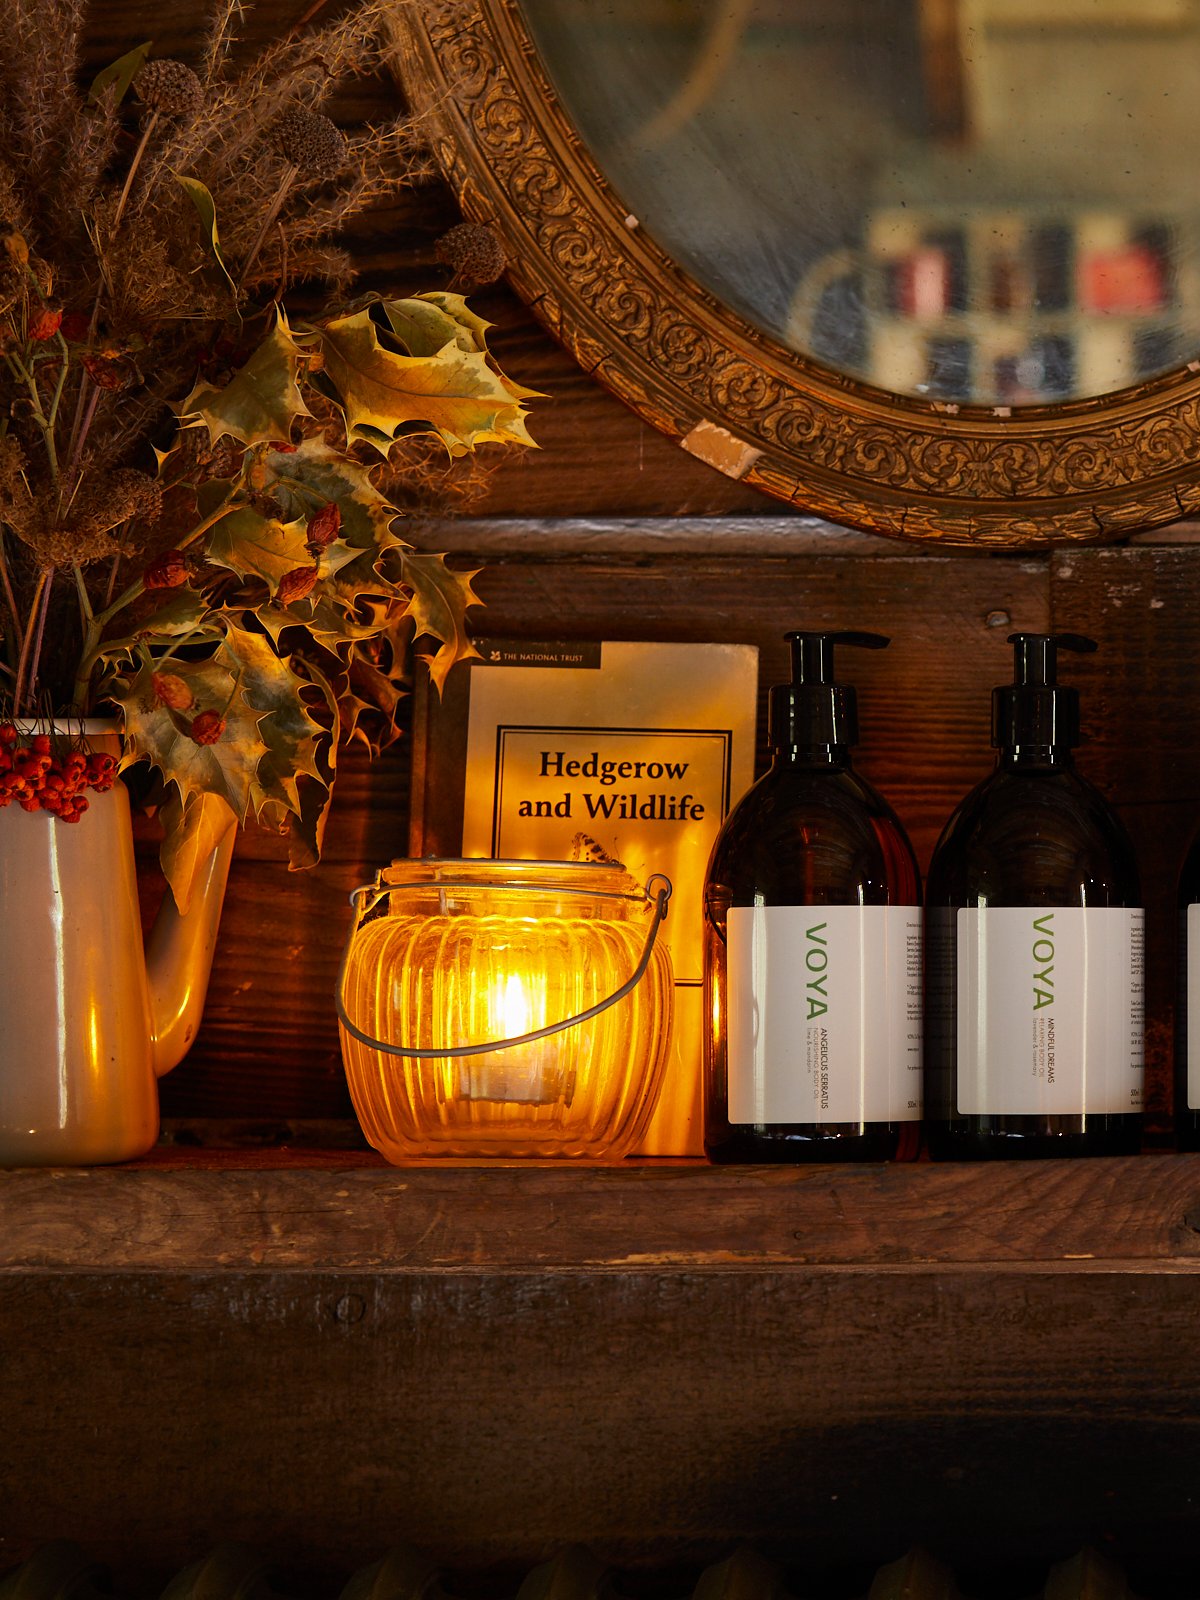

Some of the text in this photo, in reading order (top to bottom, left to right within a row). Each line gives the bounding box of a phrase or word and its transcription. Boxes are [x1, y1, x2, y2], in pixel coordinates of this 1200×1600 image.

[539, 751, 690, 786] Hedgerow
[518, 792, 705, 821] and Wildlife
[805, 922, 828, 1021] VOYA
[1033, 914, 1055, 1010] VOYA
[820, 1028, 829, 1109] ANGELICUS SERRATUS
[1047, 1018, 1055, 1083] MINDFUL DREAMS
